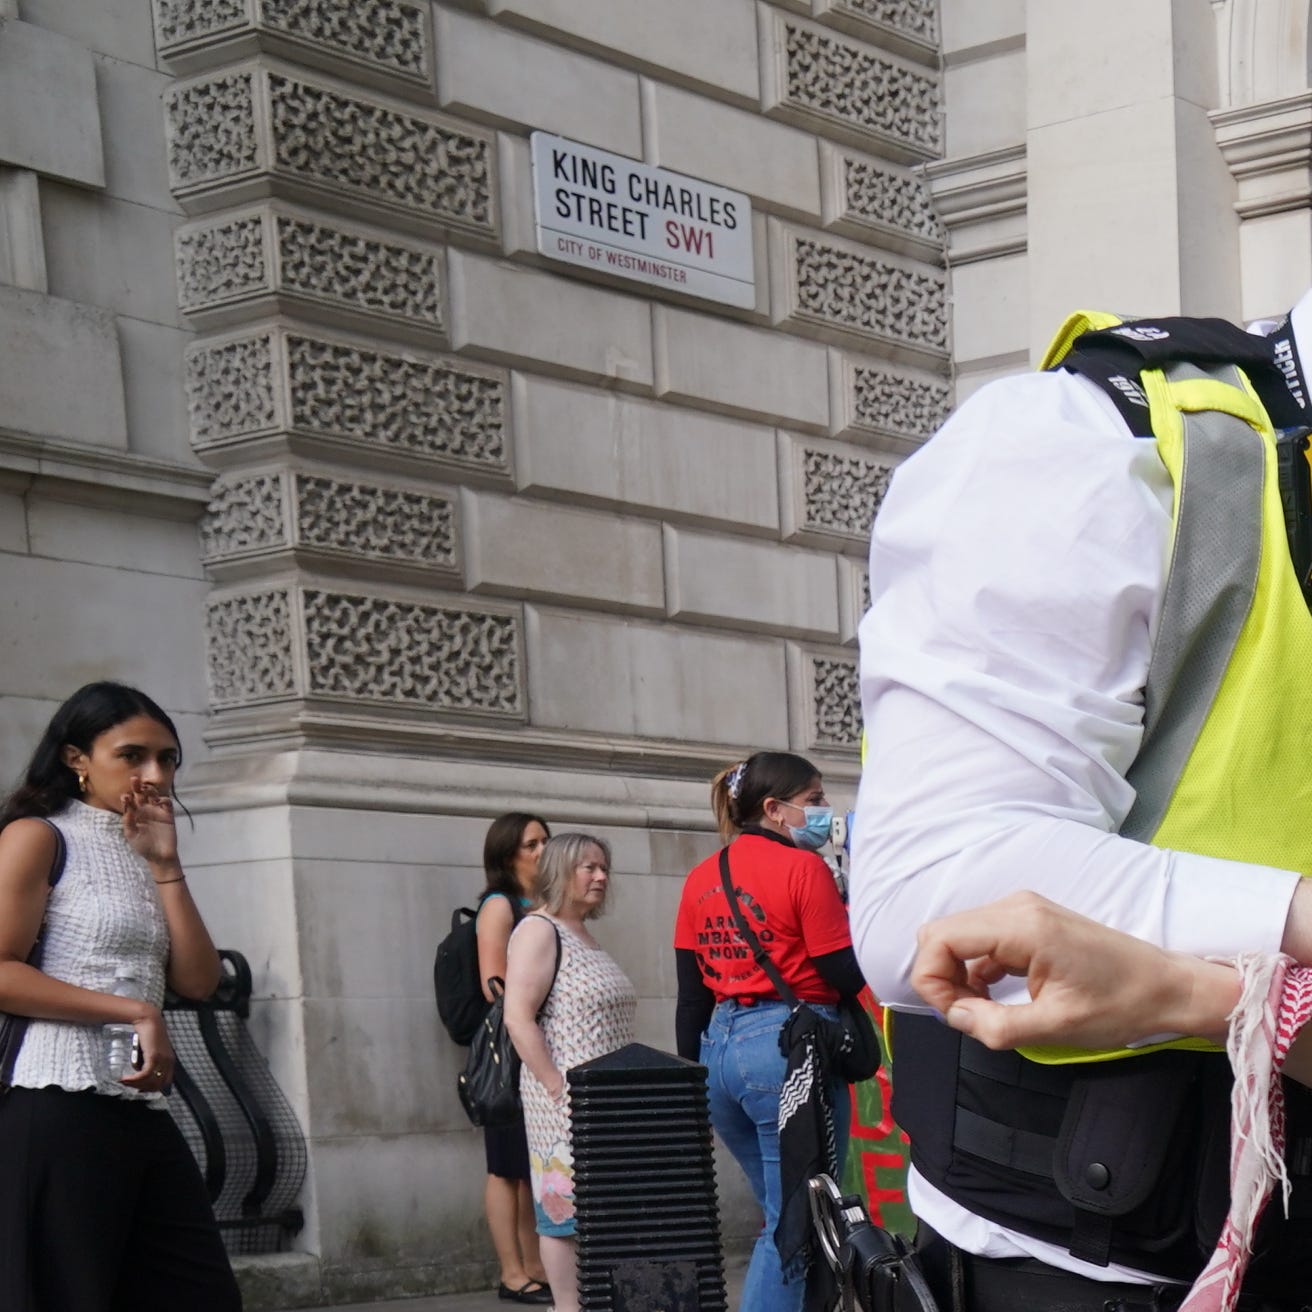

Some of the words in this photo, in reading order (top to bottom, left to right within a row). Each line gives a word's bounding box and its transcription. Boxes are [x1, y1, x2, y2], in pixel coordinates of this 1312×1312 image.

[552, 149, 616, 195] KING
[628, 173, 737, 230] CHARLES
[555, 188, 649, 240] STREET
[665, 220, 714, 259] SW1
[557, 238, 584, 256] CITY
[588, 246, 602, 260] OF
[605, 250, 687, 284] WESTMINSTER
